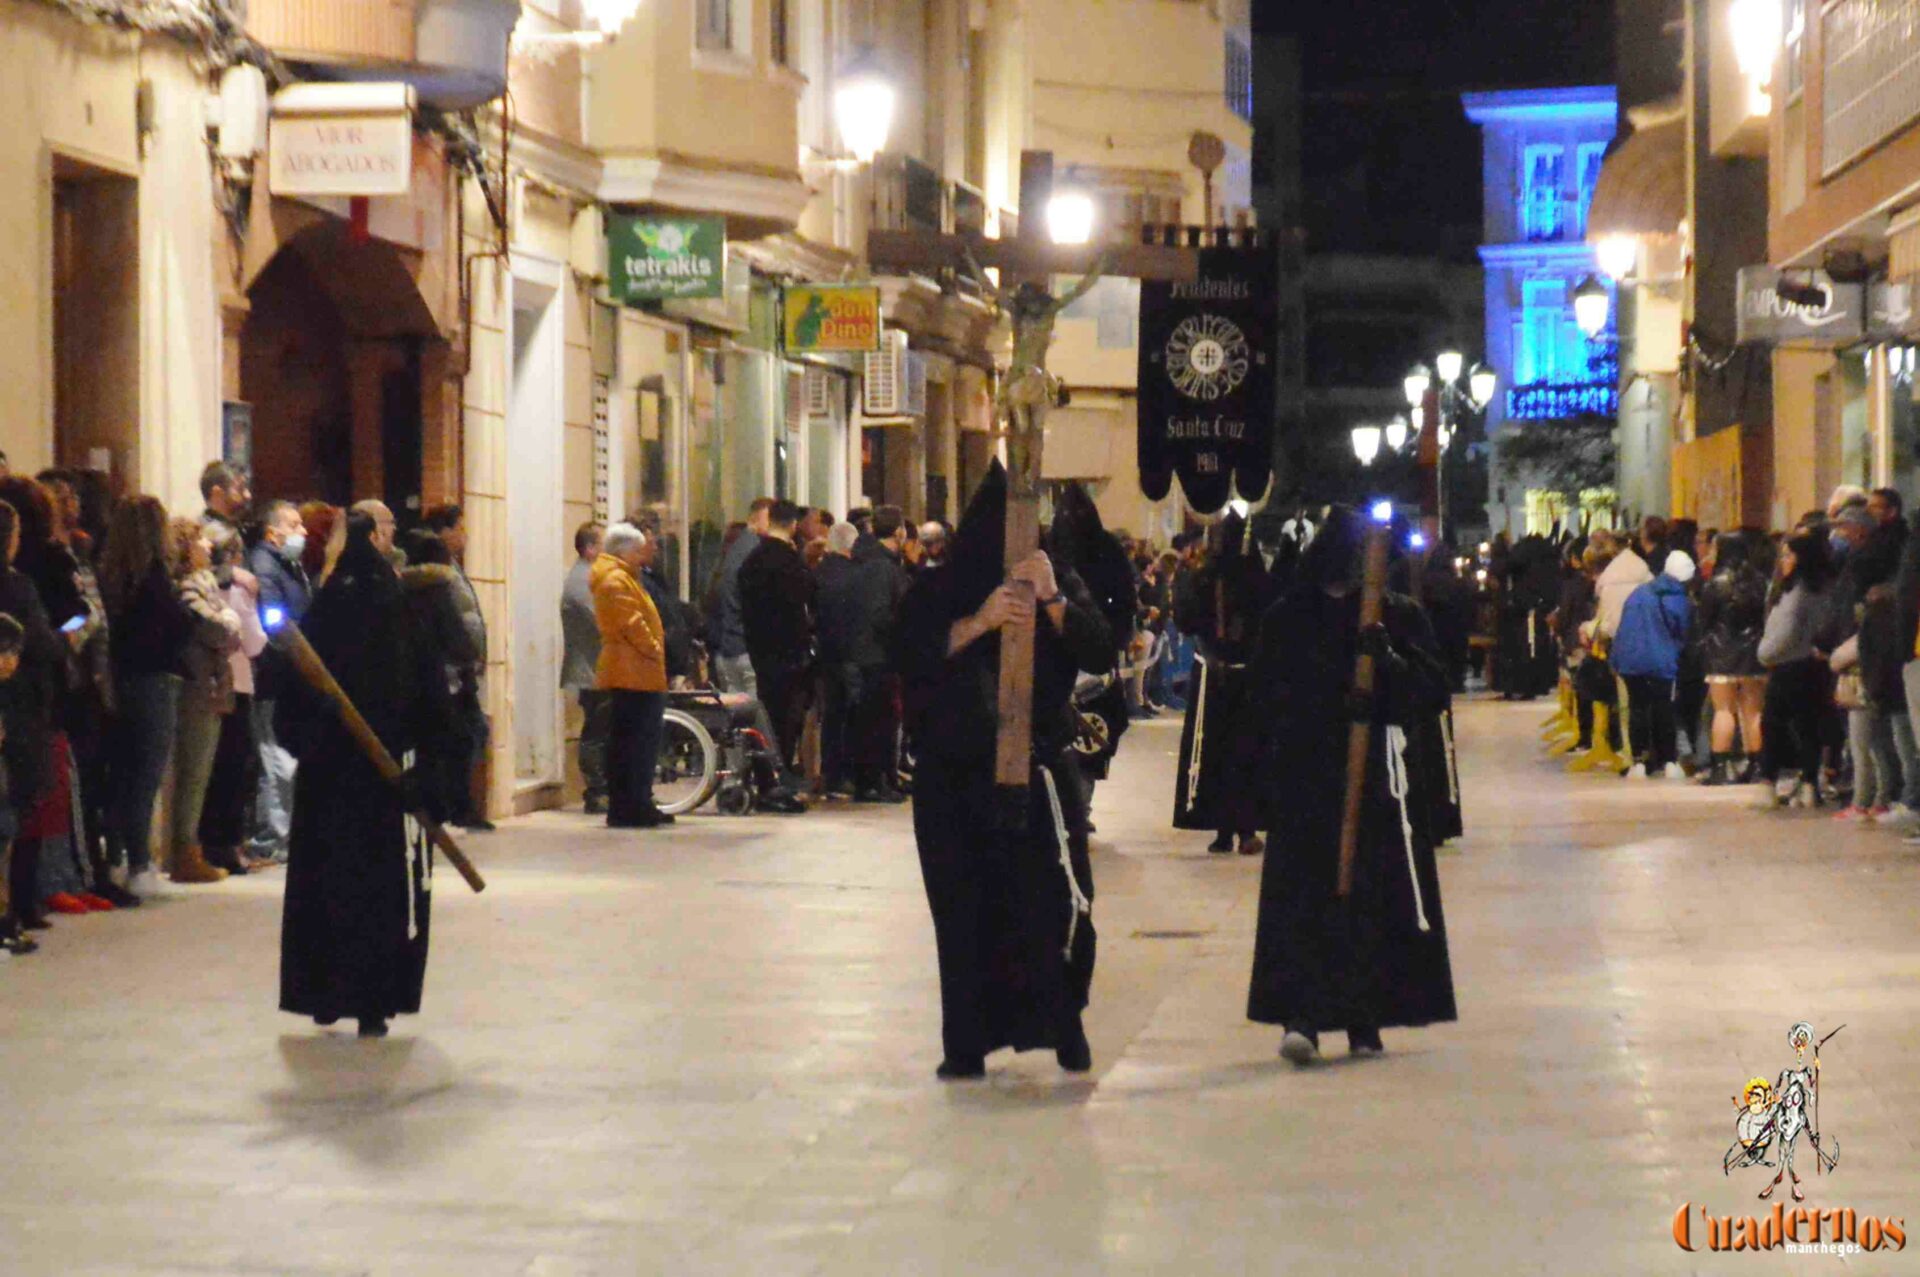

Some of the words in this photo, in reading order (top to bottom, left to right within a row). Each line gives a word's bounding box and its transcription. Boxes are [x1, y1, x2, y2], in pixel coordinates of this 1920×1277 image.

[625, 254, 712, 276] tetrakis
[831, 297, 872, 317] don
[820, 318, 871, 338] Dino
[1167, 414, 1210, 438] Santa
[1213, 413, 1246, 438] Cruz
